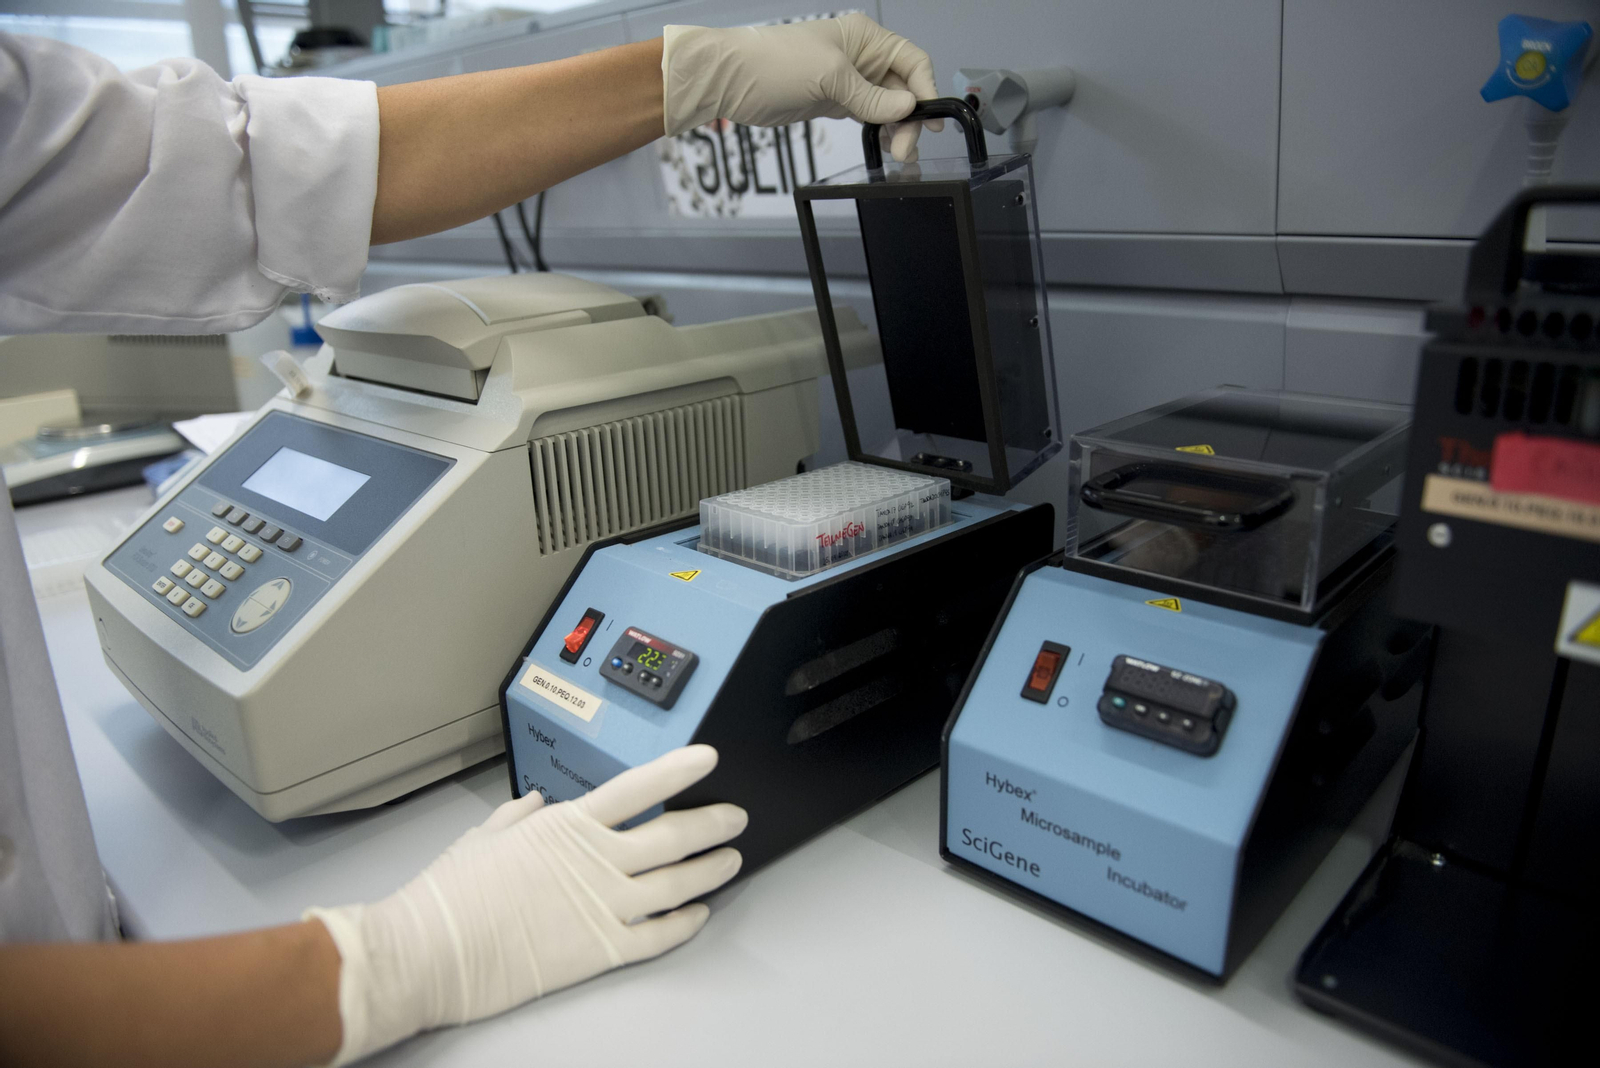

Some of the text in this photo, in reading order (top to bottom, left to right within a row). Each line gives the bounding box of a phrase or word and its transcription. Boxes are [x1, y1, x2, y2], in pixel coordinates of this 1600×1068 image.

[961, 827, 1041, 878] SciGene
[1020, 807, 1121, 862] Microsample
[1107, 866, 1188, 912] Incubator
